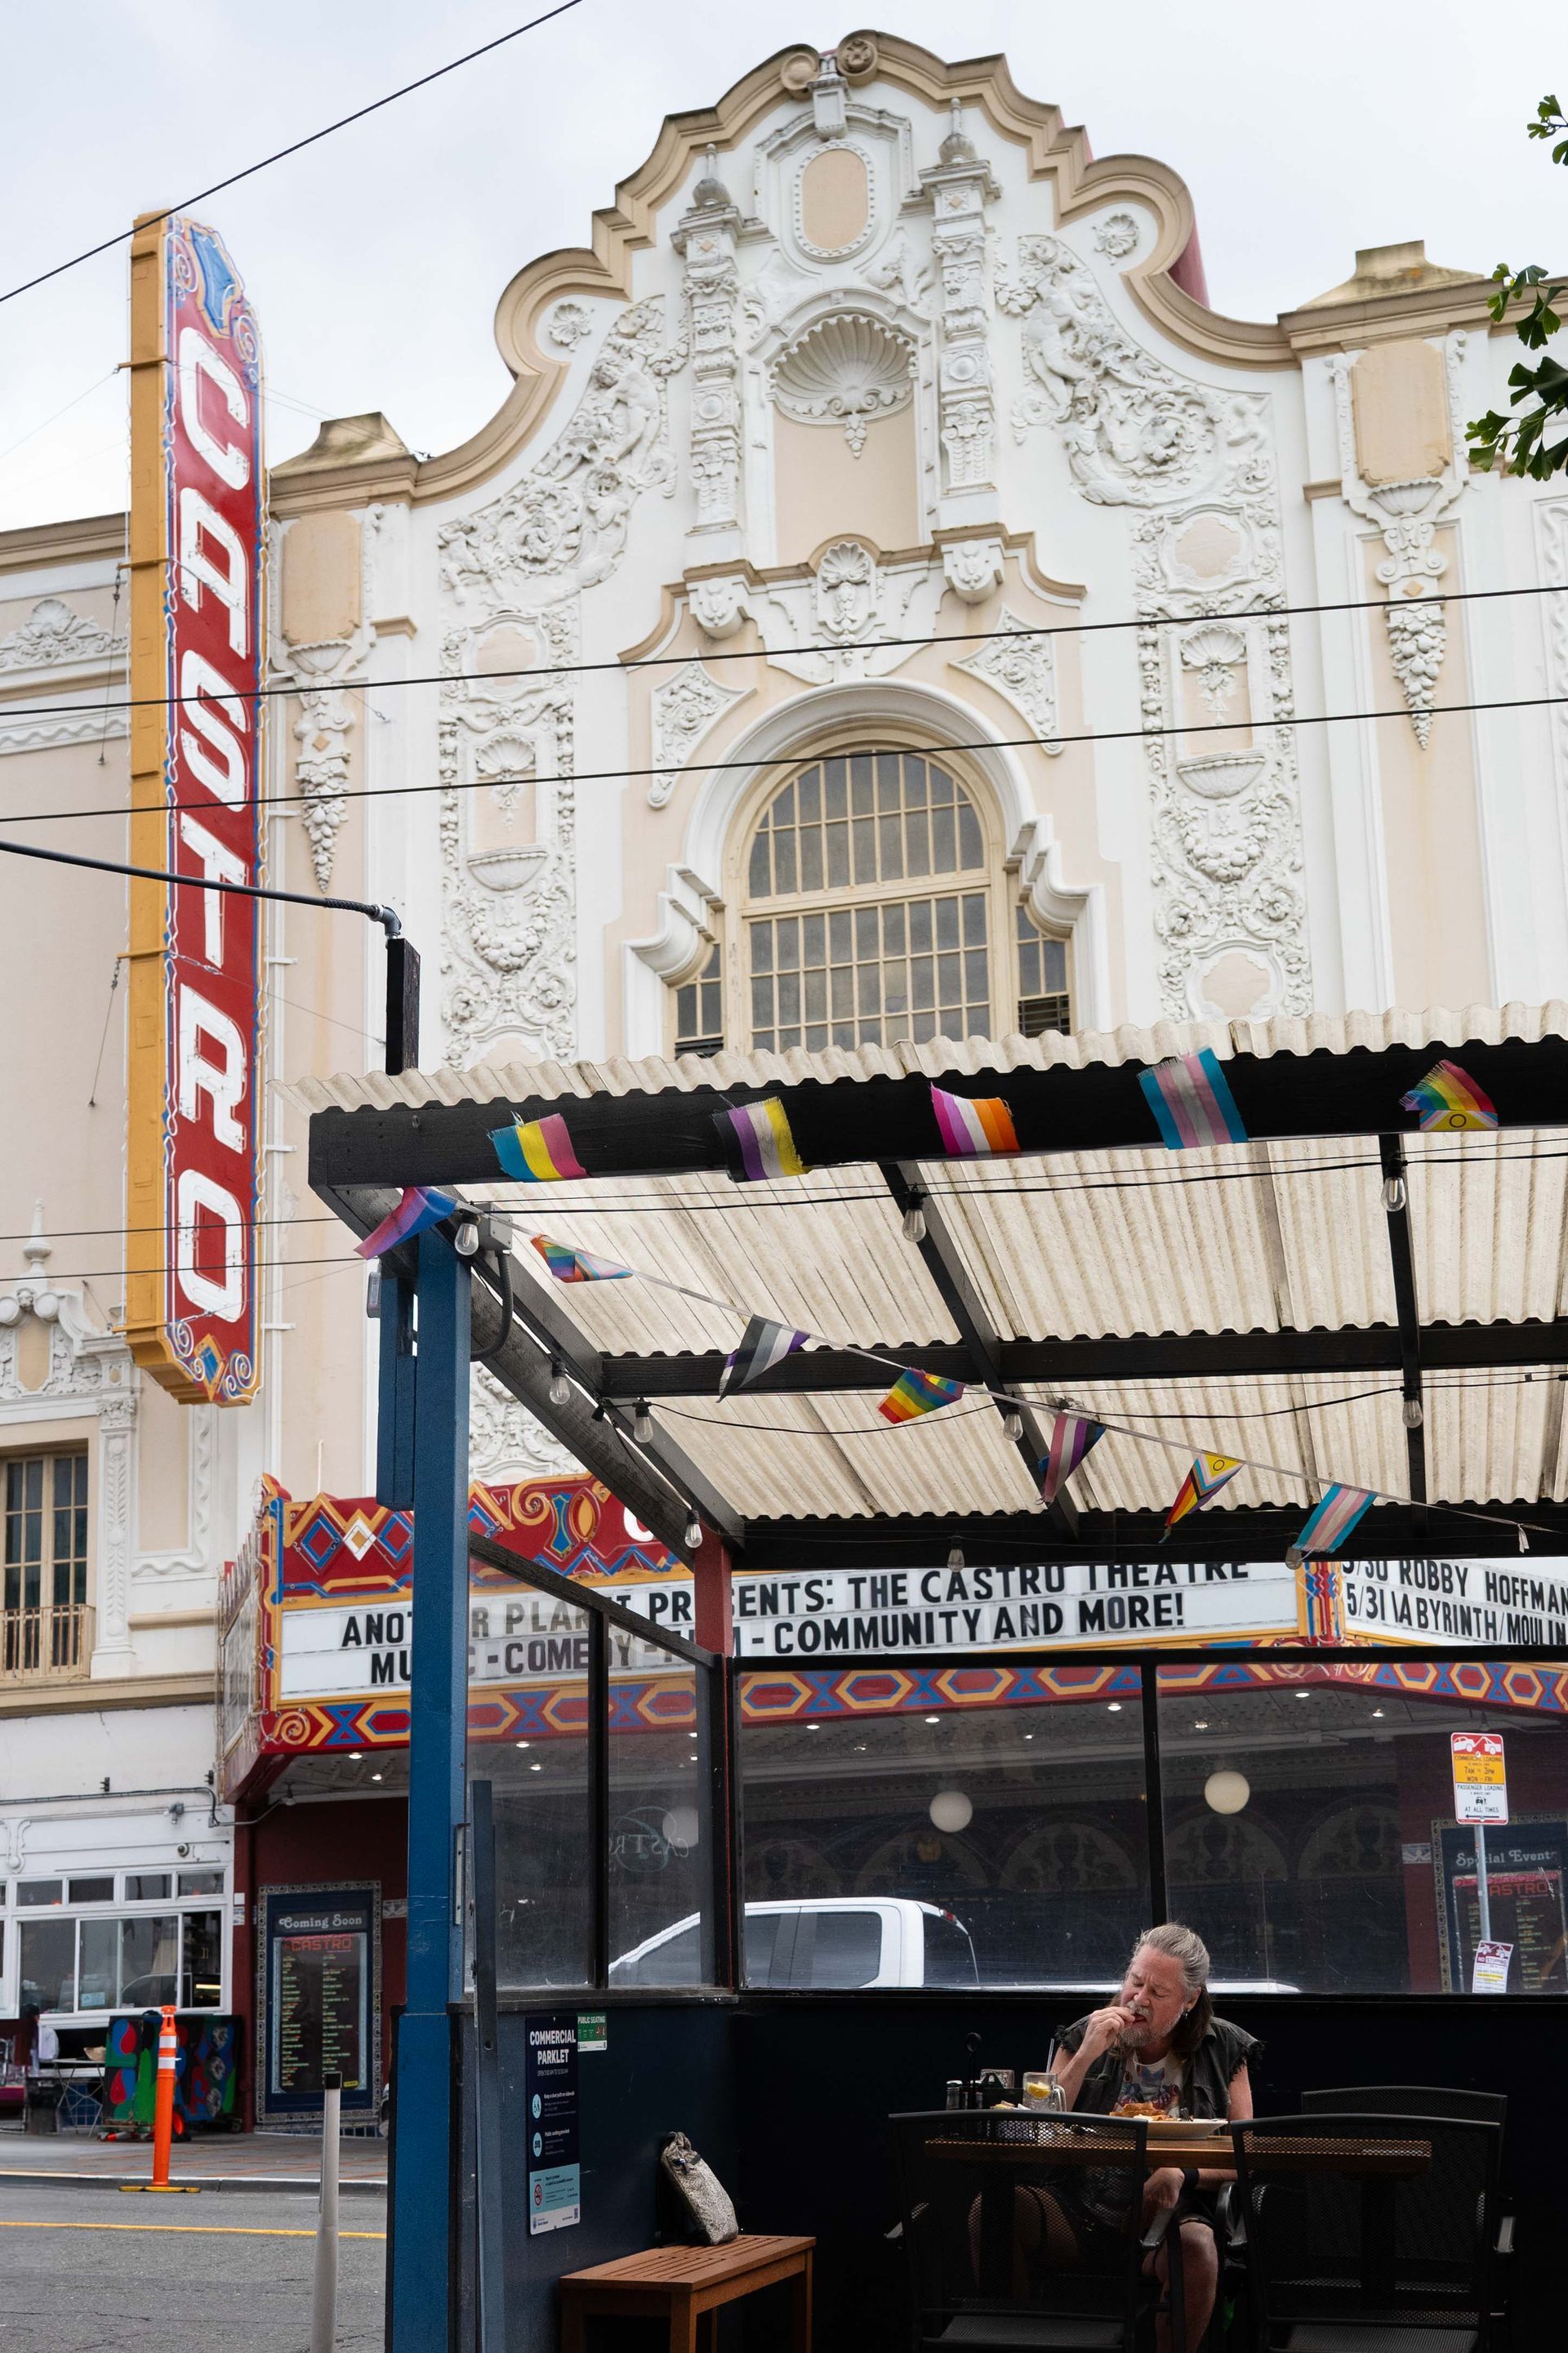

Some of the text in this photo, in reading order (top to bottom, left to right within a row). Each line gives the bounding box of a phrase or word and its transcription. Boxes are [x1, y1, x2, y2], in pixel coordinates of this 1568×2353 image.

[177, 325, 251, 1323] CASTRO
[848, 1573, 908, 1609] THE
[1400, 1560, 1468, 1597] ROBBY
[1347, 1583, 1386, 1621] 5/31
[774, 1608, 981, 1654] COMMUNITY
[993, 1602, 1062, 1643] AND
[1079, 1593, 1183, 1633] MORE!
[278, 1914, 363, 1929] Coming Soon
[292, 1938, 352, 1951] CASTRO
[529, 2030, 577, 2046] COMMERCIAL
[537, 2048, 569, 2065] PARKLET
